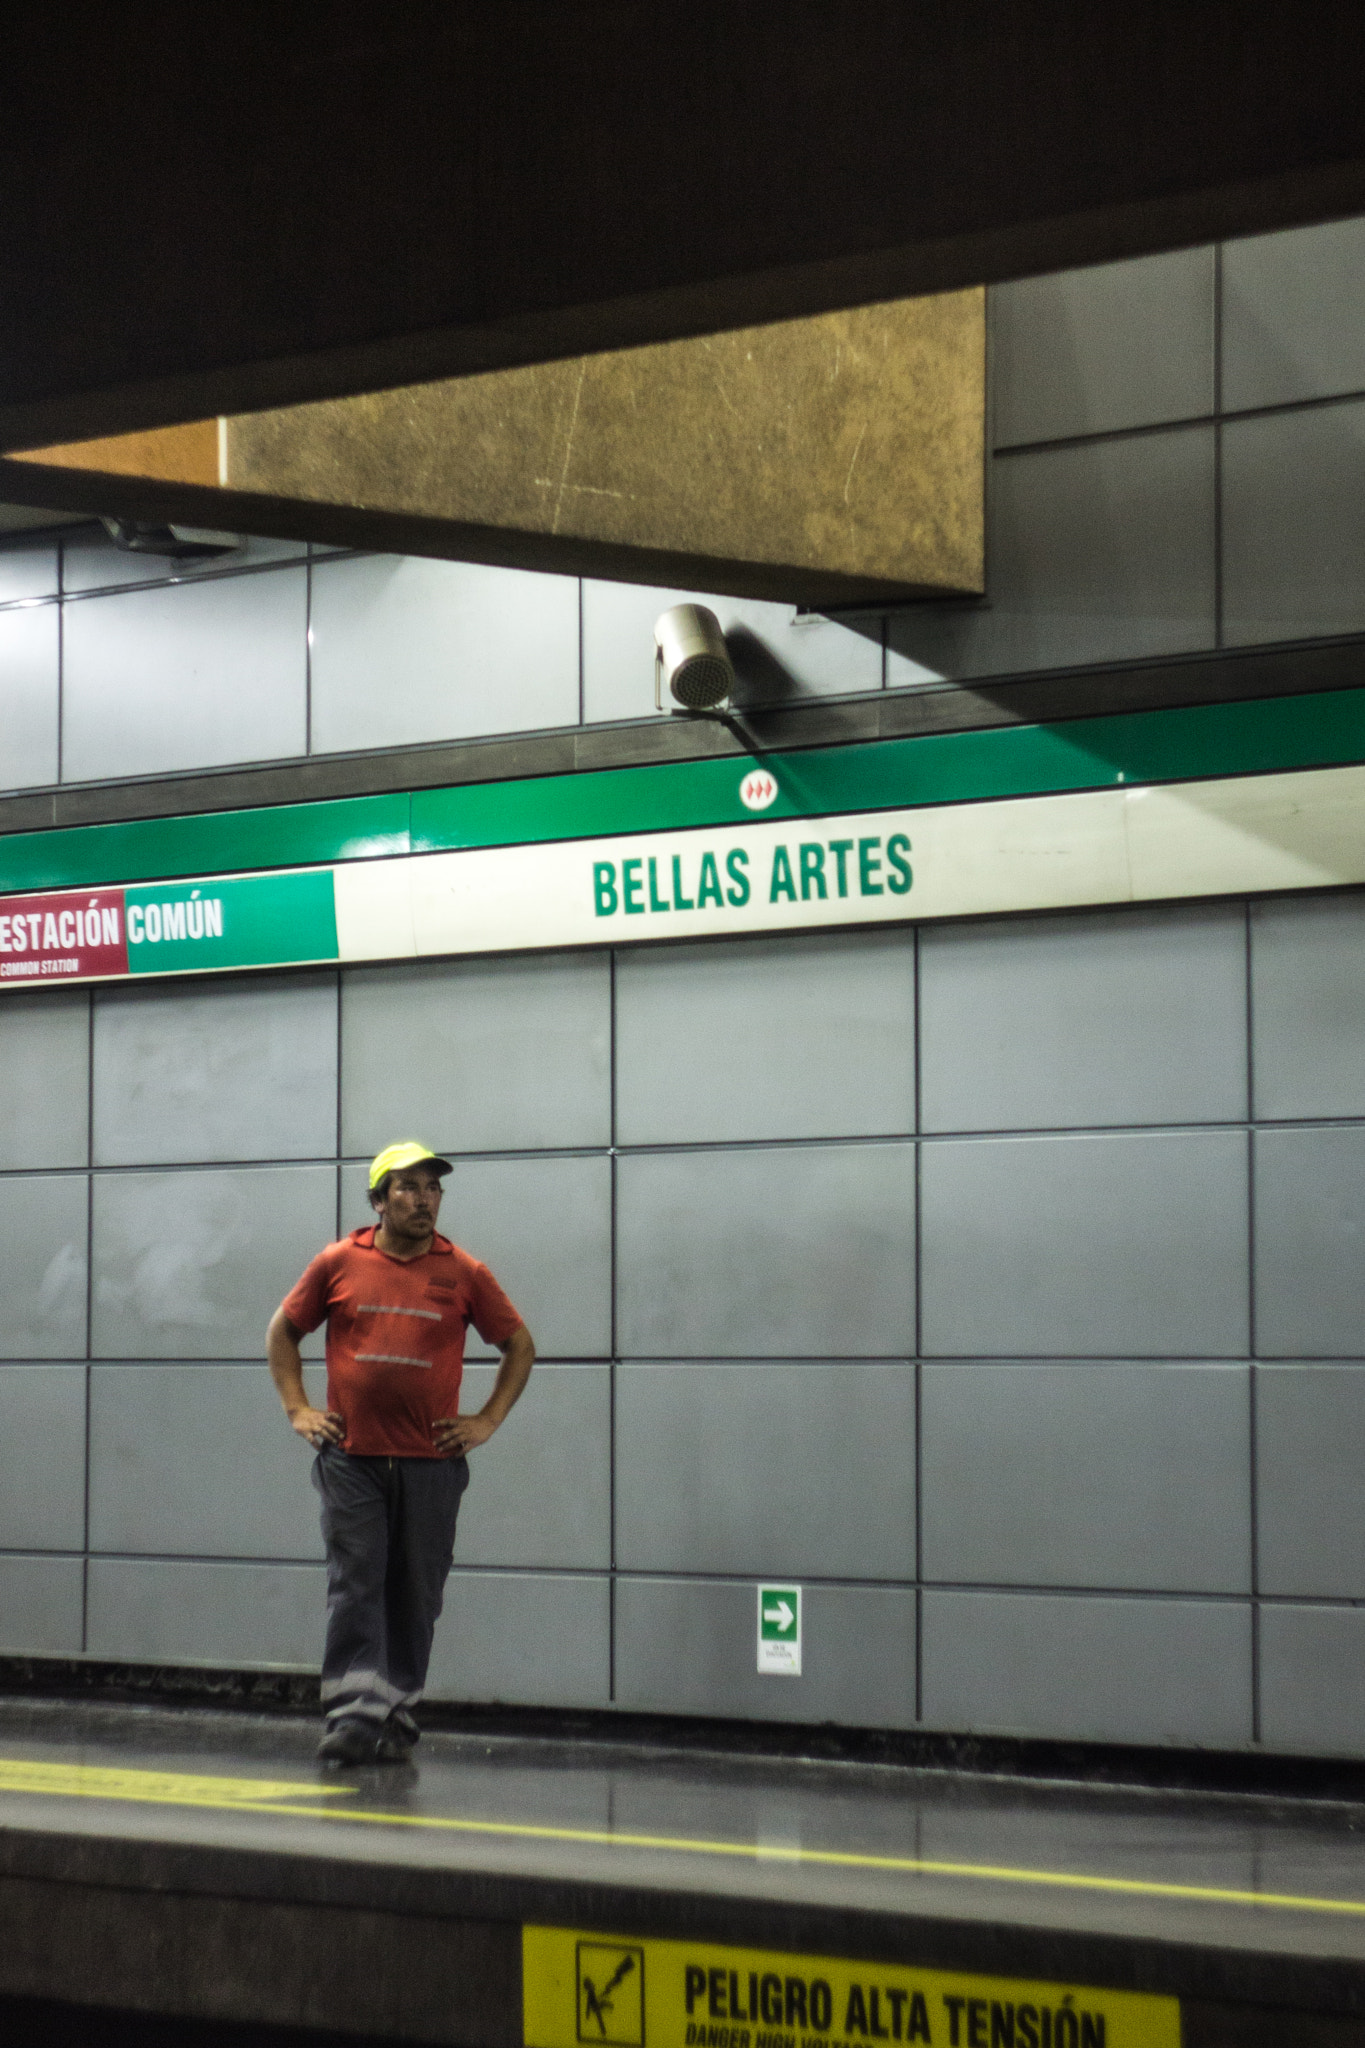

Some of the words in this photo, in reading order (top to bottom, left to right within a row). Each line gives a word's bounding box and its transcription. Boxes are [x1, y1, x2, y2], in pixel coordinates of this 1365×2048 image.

[593, 848, 750, 917] BELLAS
[769, 833, 913, 903] ARTES
[0, 899, 119, 952] ESTACIÓN
[127, 890, 223, 944] COMÚN
[0, 961, 39, 977] COMMON
[41, 958, 78, 974] STATION
[685, 1964, 832, 2031] PELIGRO
[845, 1984, 932, 2044] ALTA
[942, 1994, 1106, 2048] TENSIÓN
[685, 2022, 750, 2048] DANGER
